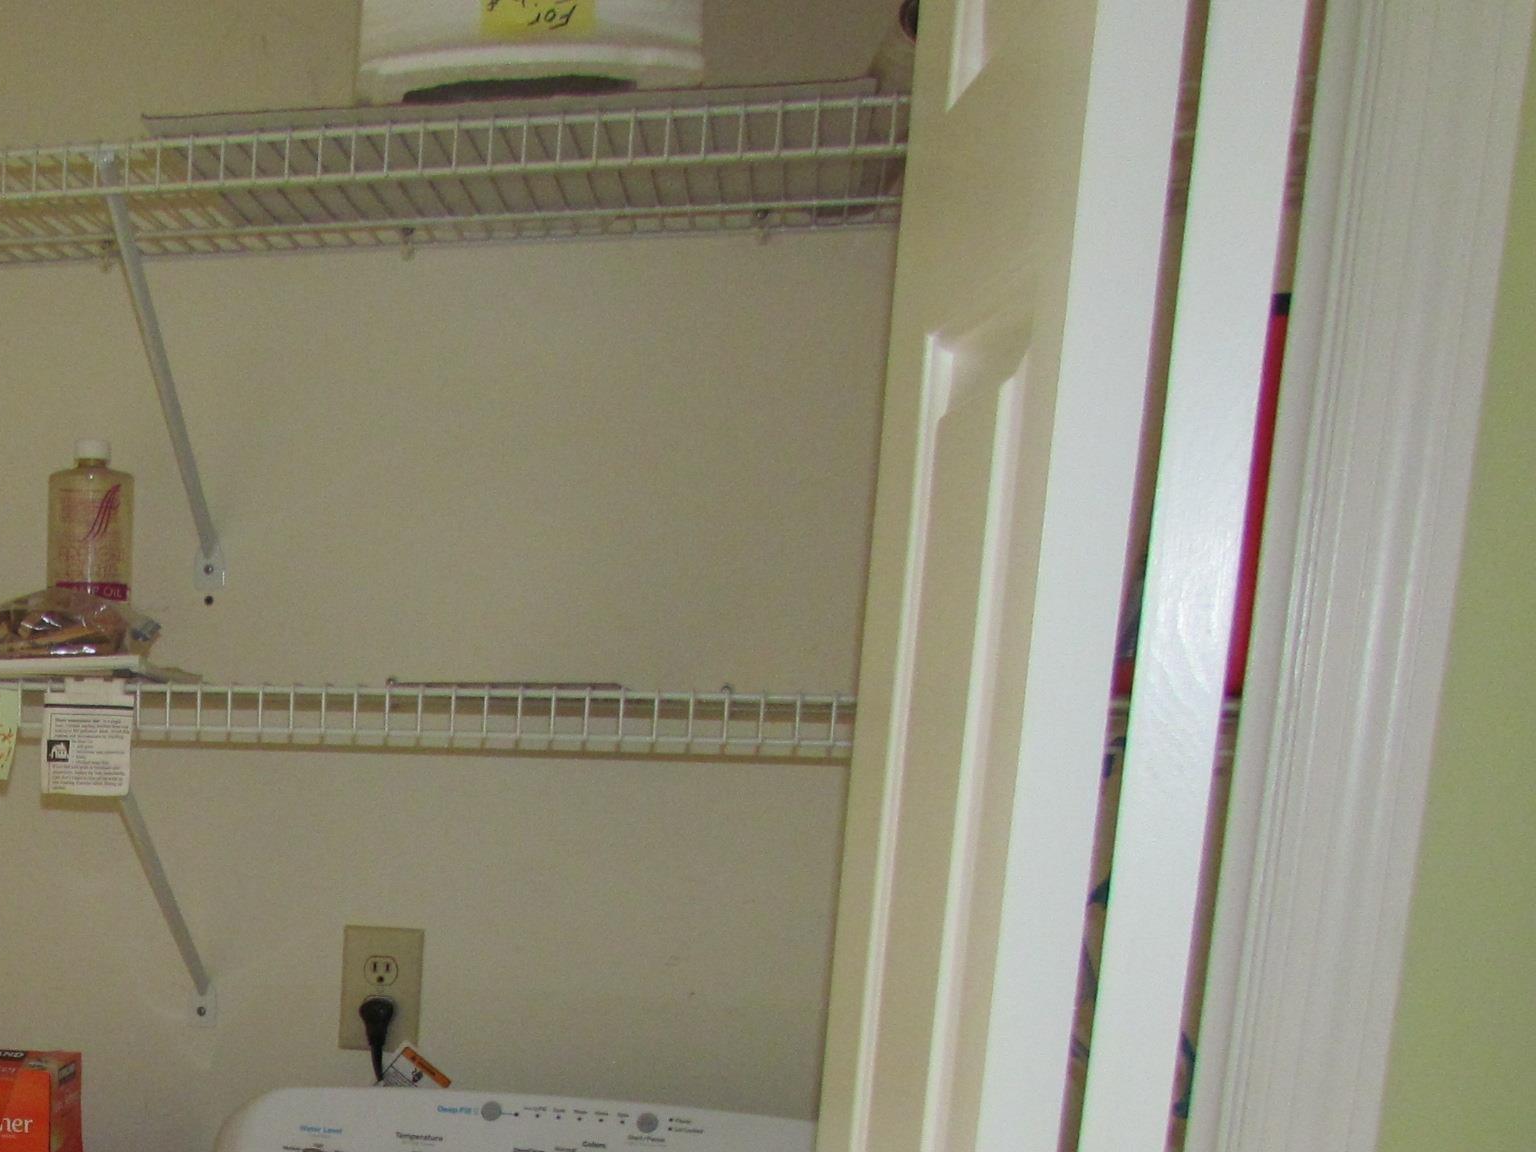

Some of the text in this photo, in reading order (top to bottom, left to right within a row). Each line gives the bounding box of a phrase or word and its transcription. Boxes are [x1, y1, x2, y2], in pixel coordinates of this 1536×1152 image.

[437, 1104, 458, 1115] Deep
[299, 1124, 343, 1135] Water Level
[395, 1131, 444, 1143] Temperature
[582, 1140, 607, 1150] Colors
